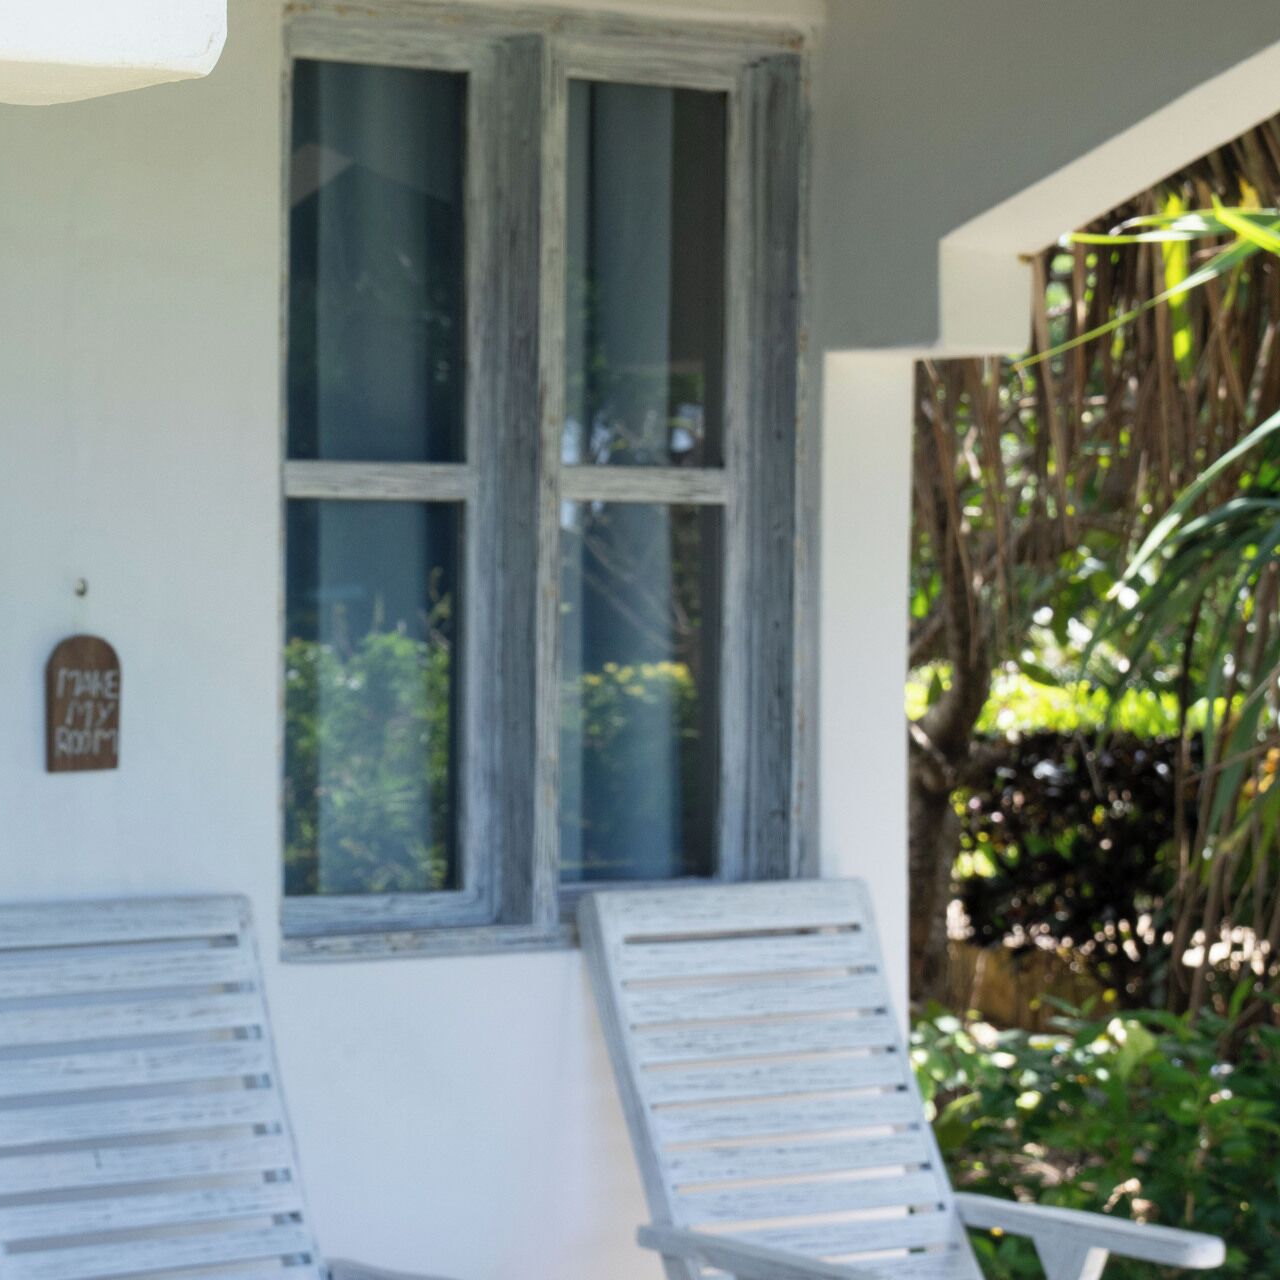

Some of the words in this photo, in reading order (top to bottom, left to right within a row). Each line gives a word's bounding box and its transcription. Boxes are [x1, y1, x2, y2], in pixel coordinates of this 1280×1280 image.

[56, 668, 119, 700] MAKE
[65, 699, 115, 727] MY
[54, 726, 118, 757] ROOM
